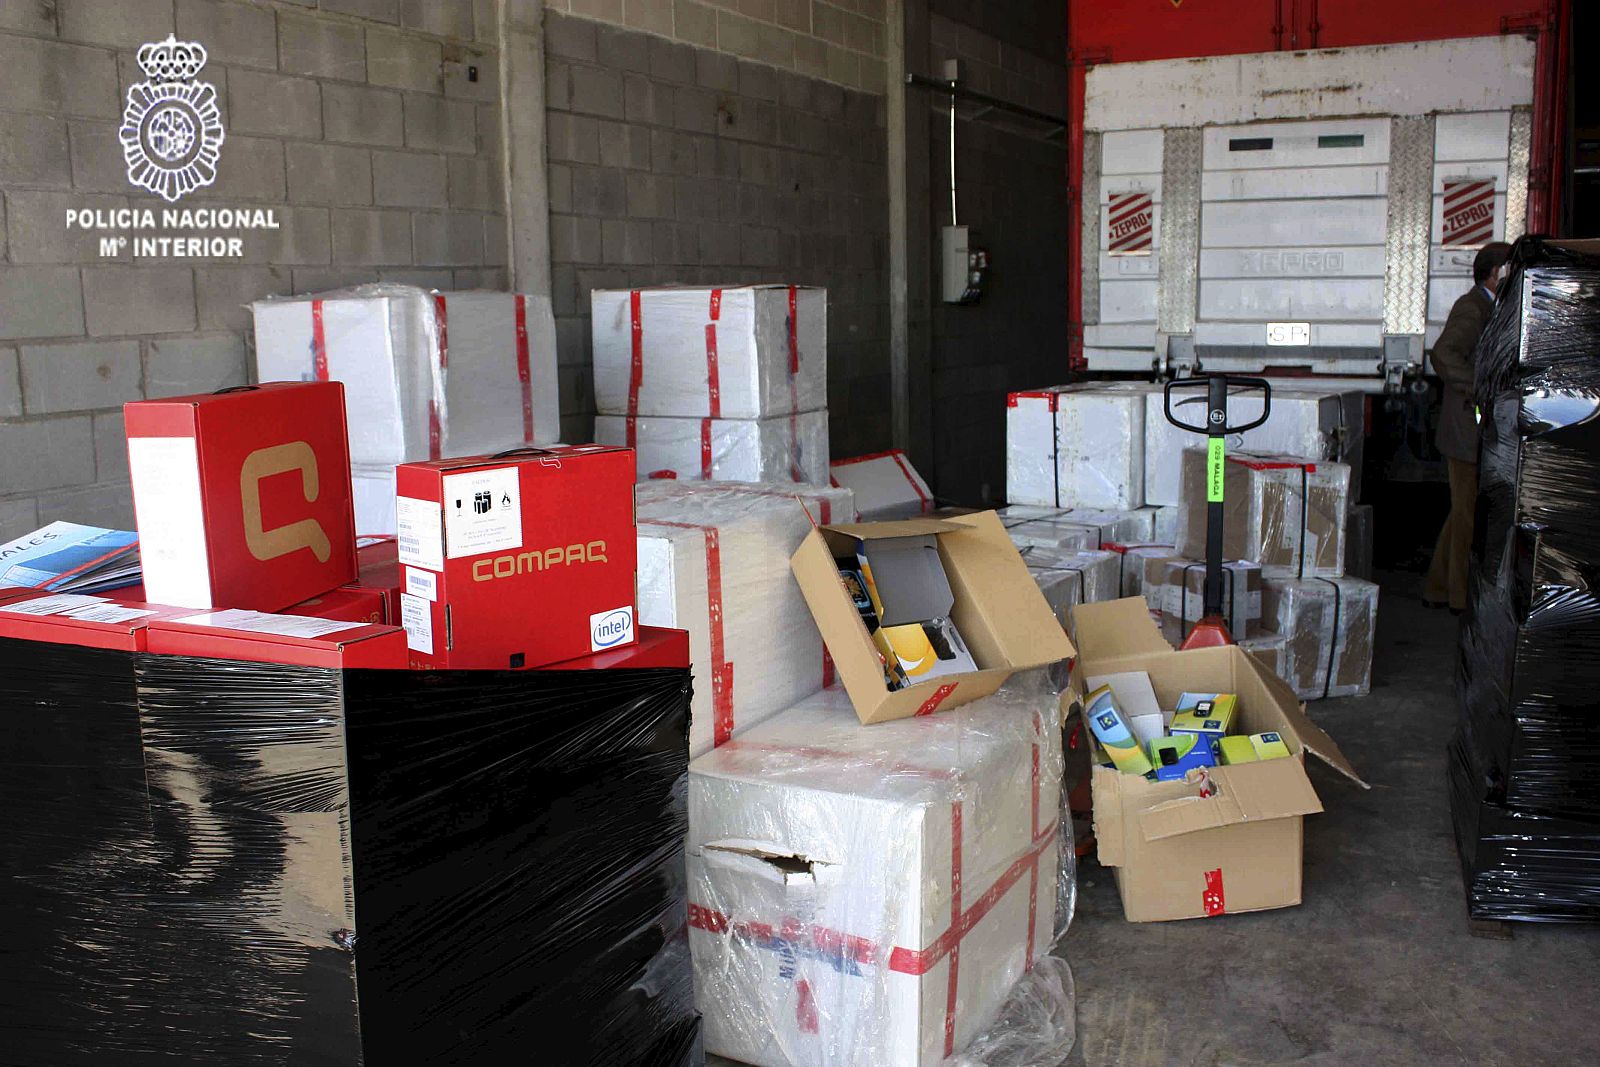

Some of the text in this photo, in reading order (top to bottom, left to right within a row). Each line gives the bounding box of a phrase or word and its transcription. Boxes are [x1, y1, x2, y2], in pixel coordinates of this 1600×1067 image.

[1112, 212, 1148, 239] ZEPRO
[1445, 203, 1489, 232] ZEPRO
[1213, 463, 1221, 496] MALAGA
[0, 532, 58, 561] ALES
[472, 540, 608, 582] COMPAQ
[598, 617, 626, 638] intel
